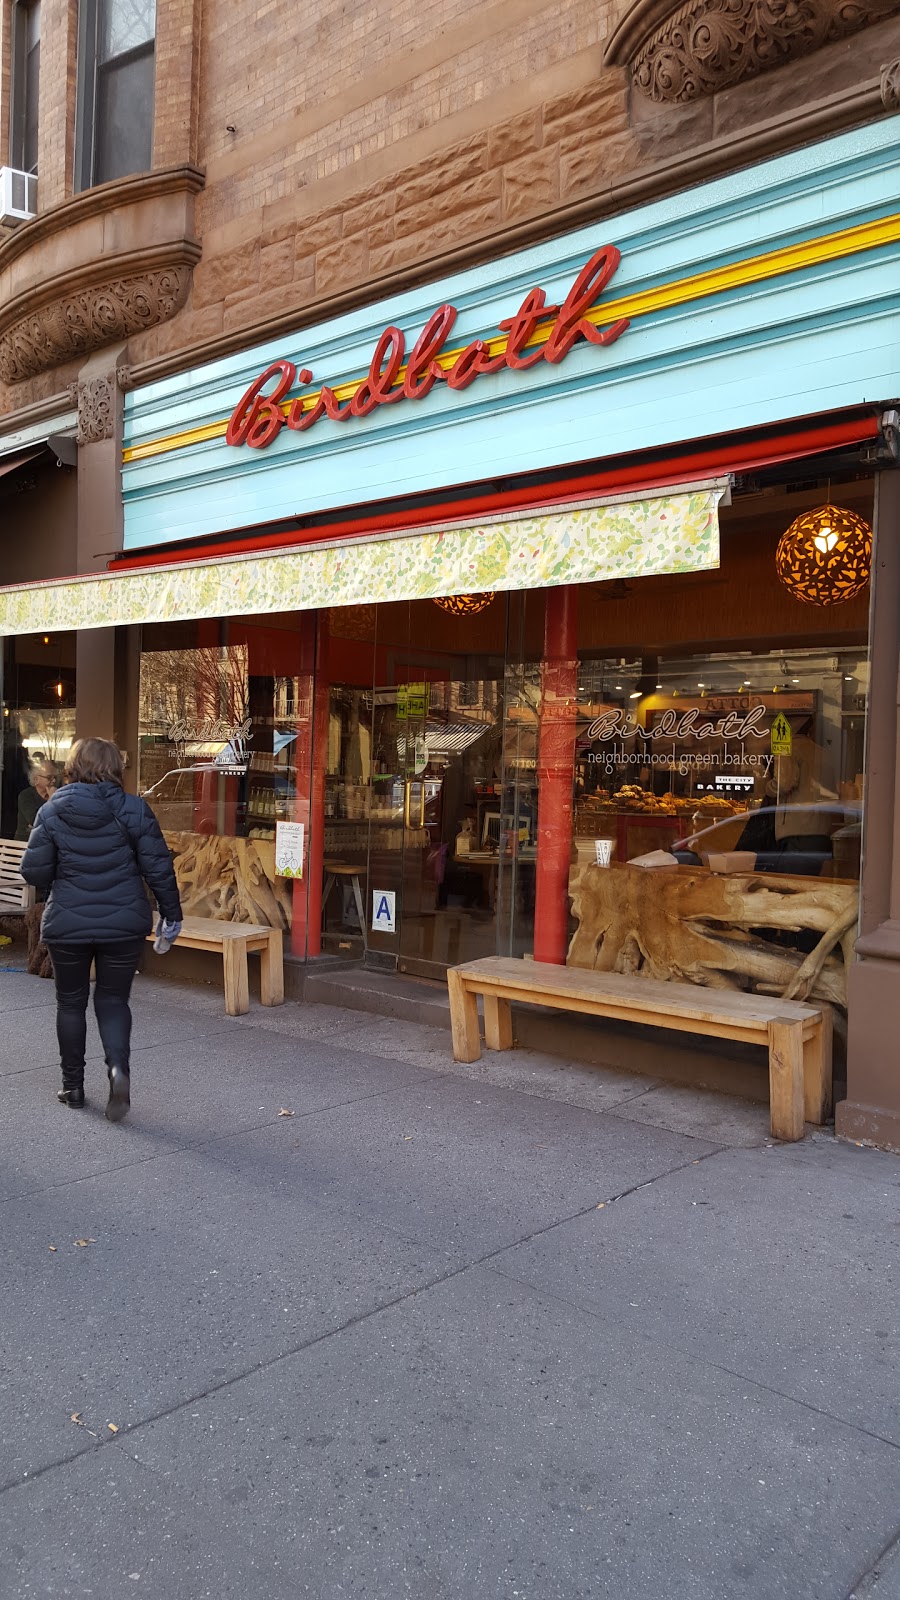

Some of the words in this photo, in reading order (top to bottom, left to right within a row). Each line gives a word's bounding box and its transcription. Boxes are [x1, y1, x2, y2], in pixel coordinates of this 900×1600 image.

[225, 243, 631, 449] Birdbath
[168, 718, 254, 741] Birdbath
[588, 705, 770, 741] Birdbath
[588, 743, 675, 775] neighborhood
[680, 753, 719, 776] green
[724, 743, 774, 778] bakery
[376, 896, 391, 920] A
